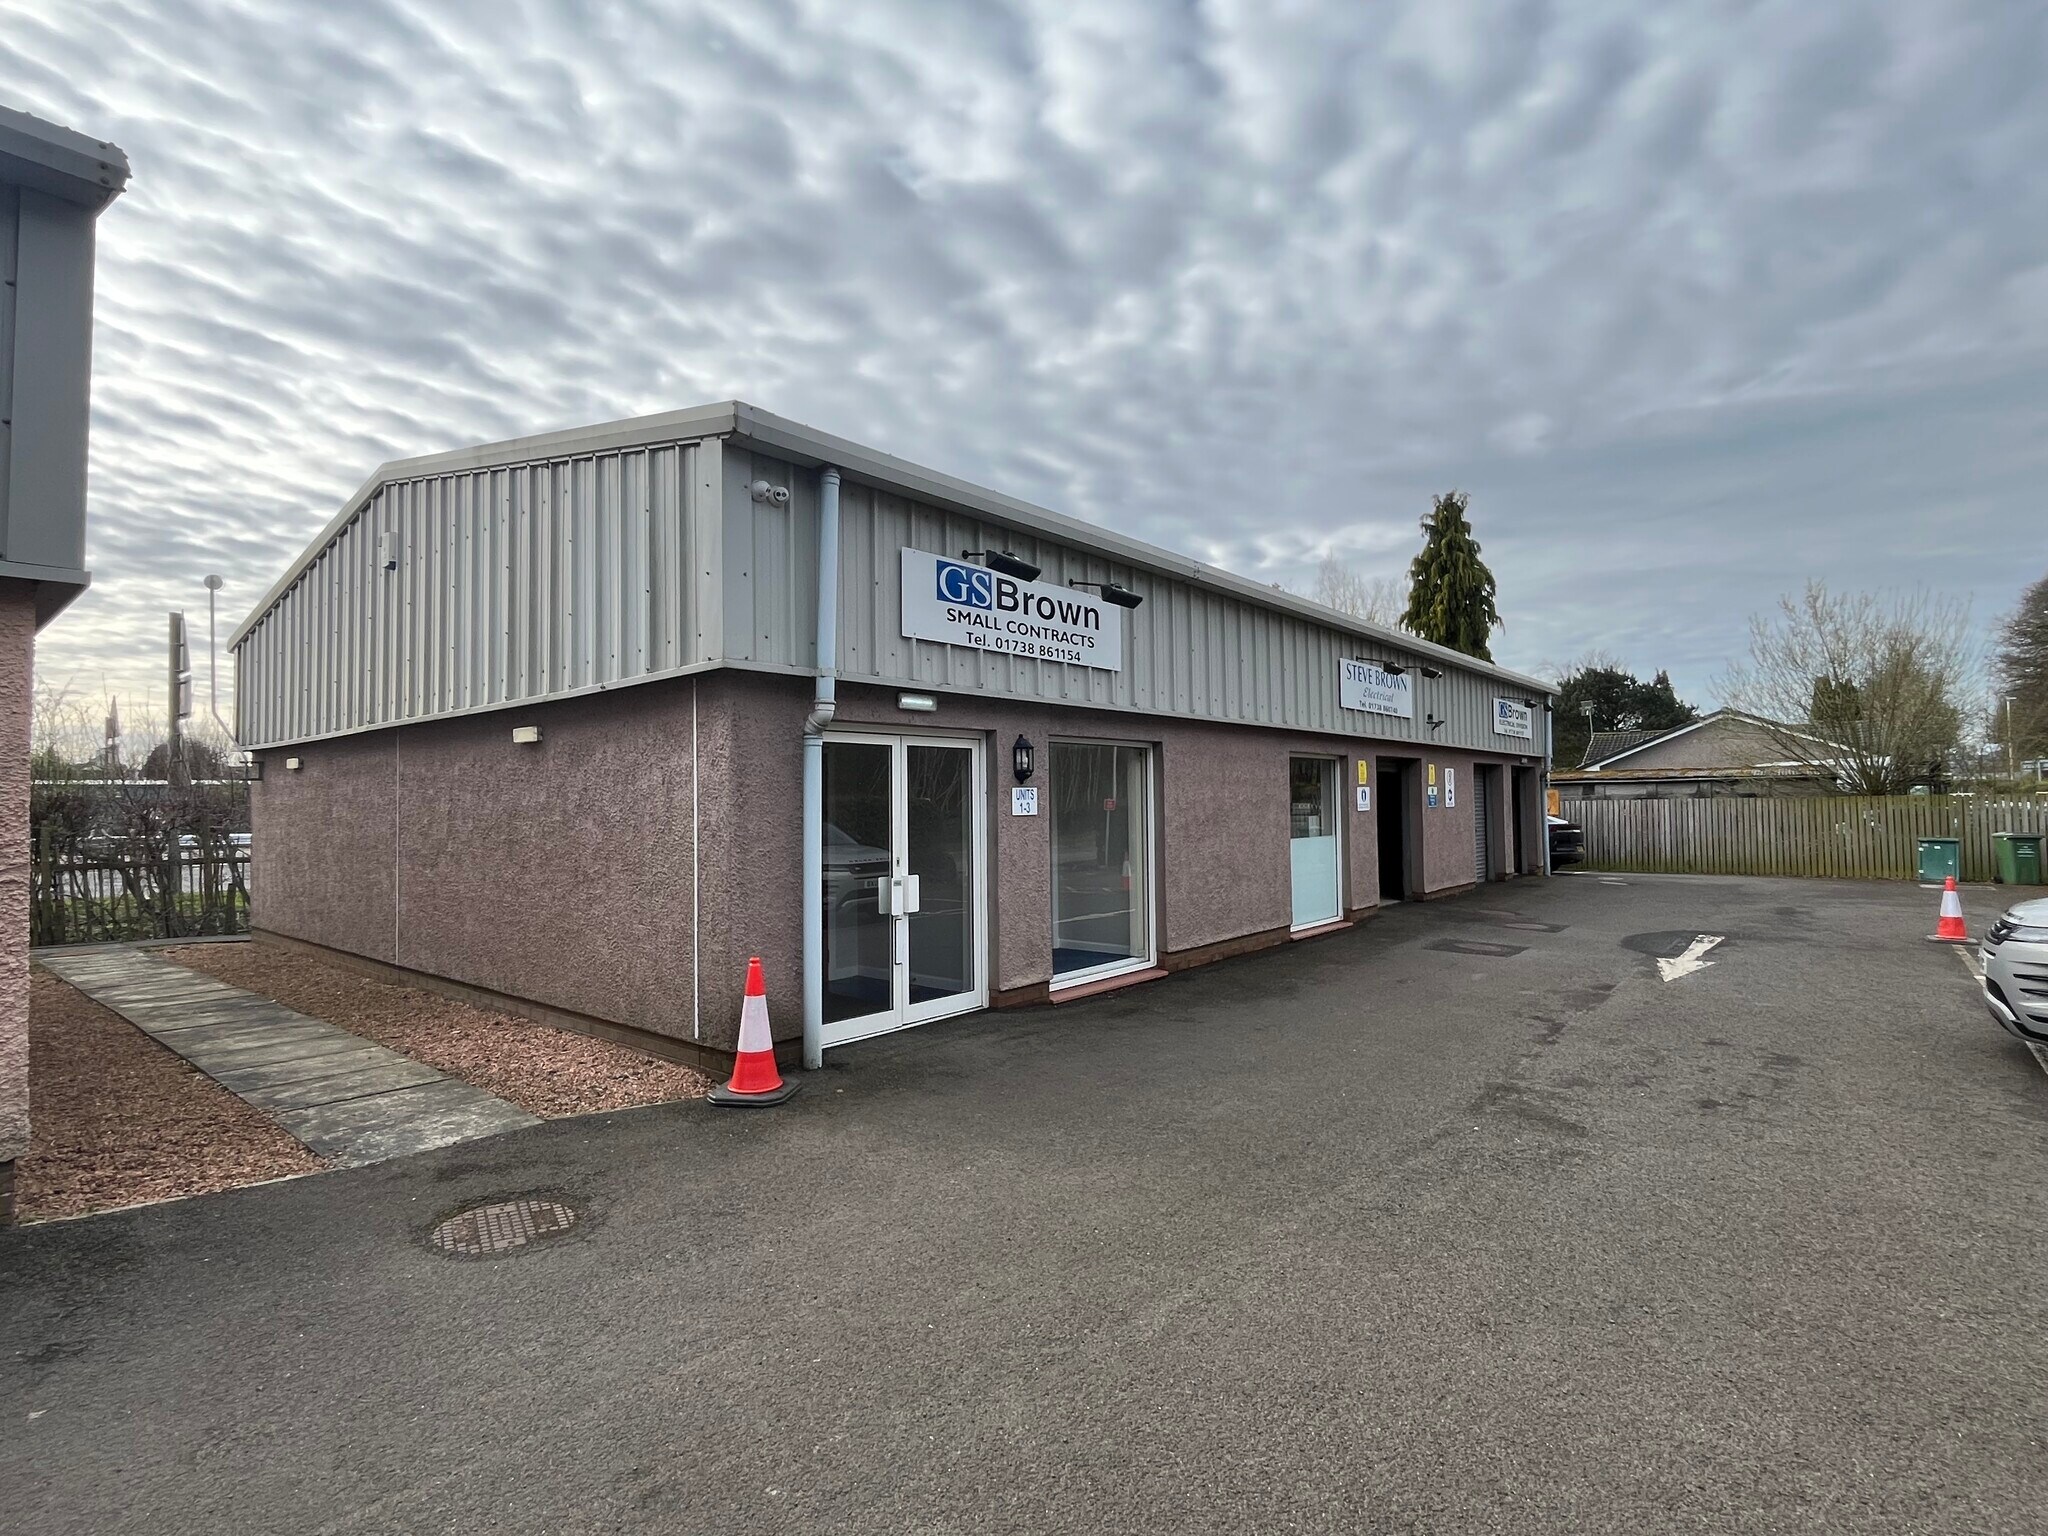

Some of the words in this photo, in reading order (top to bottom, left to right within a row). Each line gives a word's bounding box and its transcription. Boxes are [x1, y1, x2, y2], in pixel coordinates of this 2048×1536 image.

[946, 608, 1002, 631] SMALL
[1006, 620, 1095, 648] CONTRACTS
[966, 632, 991, 647] Tel.
[995, 637, 1035, 655] 01738
[1039, 645, 1081, 662] 861154
[1346, 663, 1372, 684] STEVE
[1375, 670, 1407, 691] BROWN
[1015, 789, 1034, 800] UNITS
[1019, 802, 1031, 813] 1-3
